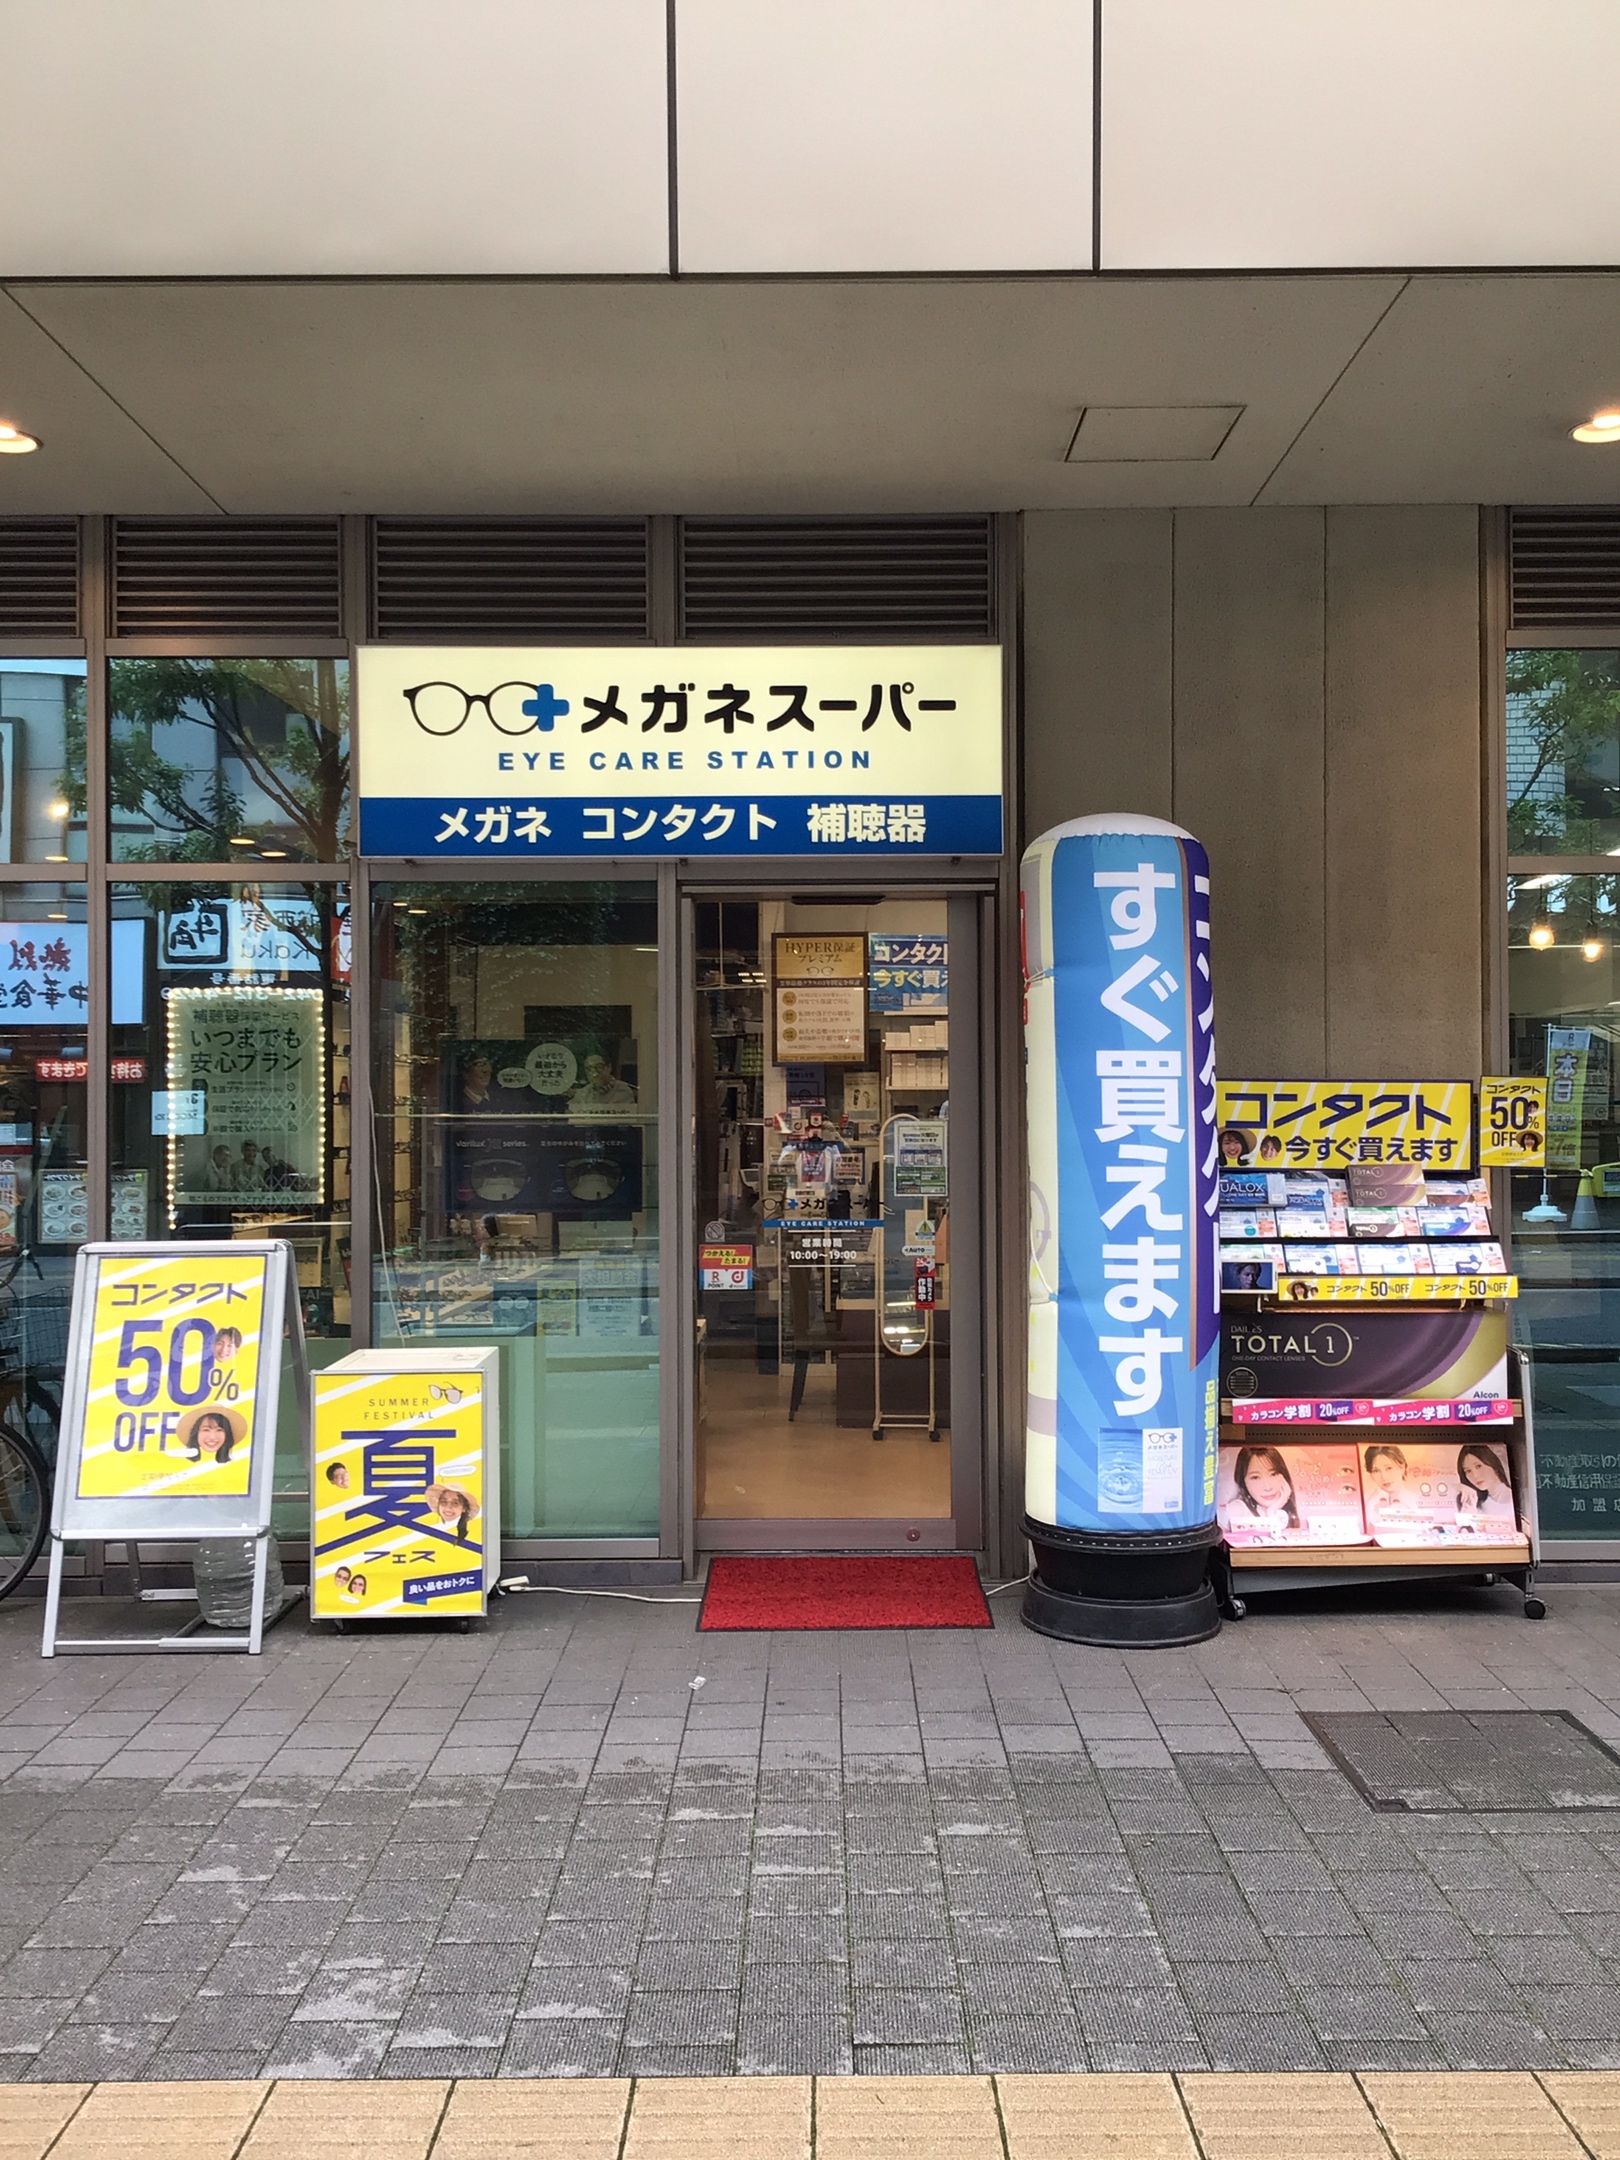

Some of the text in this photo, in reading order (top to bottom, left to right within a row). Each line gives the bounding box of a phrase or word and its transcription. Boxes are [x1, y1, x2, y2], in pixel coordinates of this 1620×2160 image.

[581, 681, 957, 735] メガネスーパー
[499, 751, 872, 771] EYE CARE STATION
[433, 804, 927, 844] メガネ コンタクト 補聴器
[190, 1027, 301, 1049] いつまでも
[190, 1051, 303, 1074] 安心プラン
[1553, 1052, 1579, 1103] 本日
[1486, 1084, 1541, 1095] コンタクト
[1224, 1092, 1452, 1131] コンタクト
[1490, 1096, 1540, 1131] 50%
[1092, 862, 1187, 1417] すぐ買えます
[1285, 1135, 1459, 1163] 今すぐ買えます
[1491, 1131, 1518, 1147] OFF
[801, 1237, 843, 1248] 営業時間
[111, 1282, 248, 1306] コンタクト
[1326, 1284, 1368, 1293] コンタクト
[1424, 1283, 1466, 1292] コンタクト
[1231, 1335, 1317, 1354] TOTAL
[368, 1397, 430, 1407] SUMMER
[1473, 1390, 1500, 1399] Alcon
[364, 1411, 435, 1420] FESTIVAL
[1250, 1403, 1312, 1421] カラコン学割
[1389, 1404, 1450, 1422] カラコン学割
[113, 1411, 181, 1452] OFF
[315, 1429, 483, 1556] 夏
[363, 1550, 436, 1563] フェス
[408, 1575, 476, 1595] 良い品をおトクに
